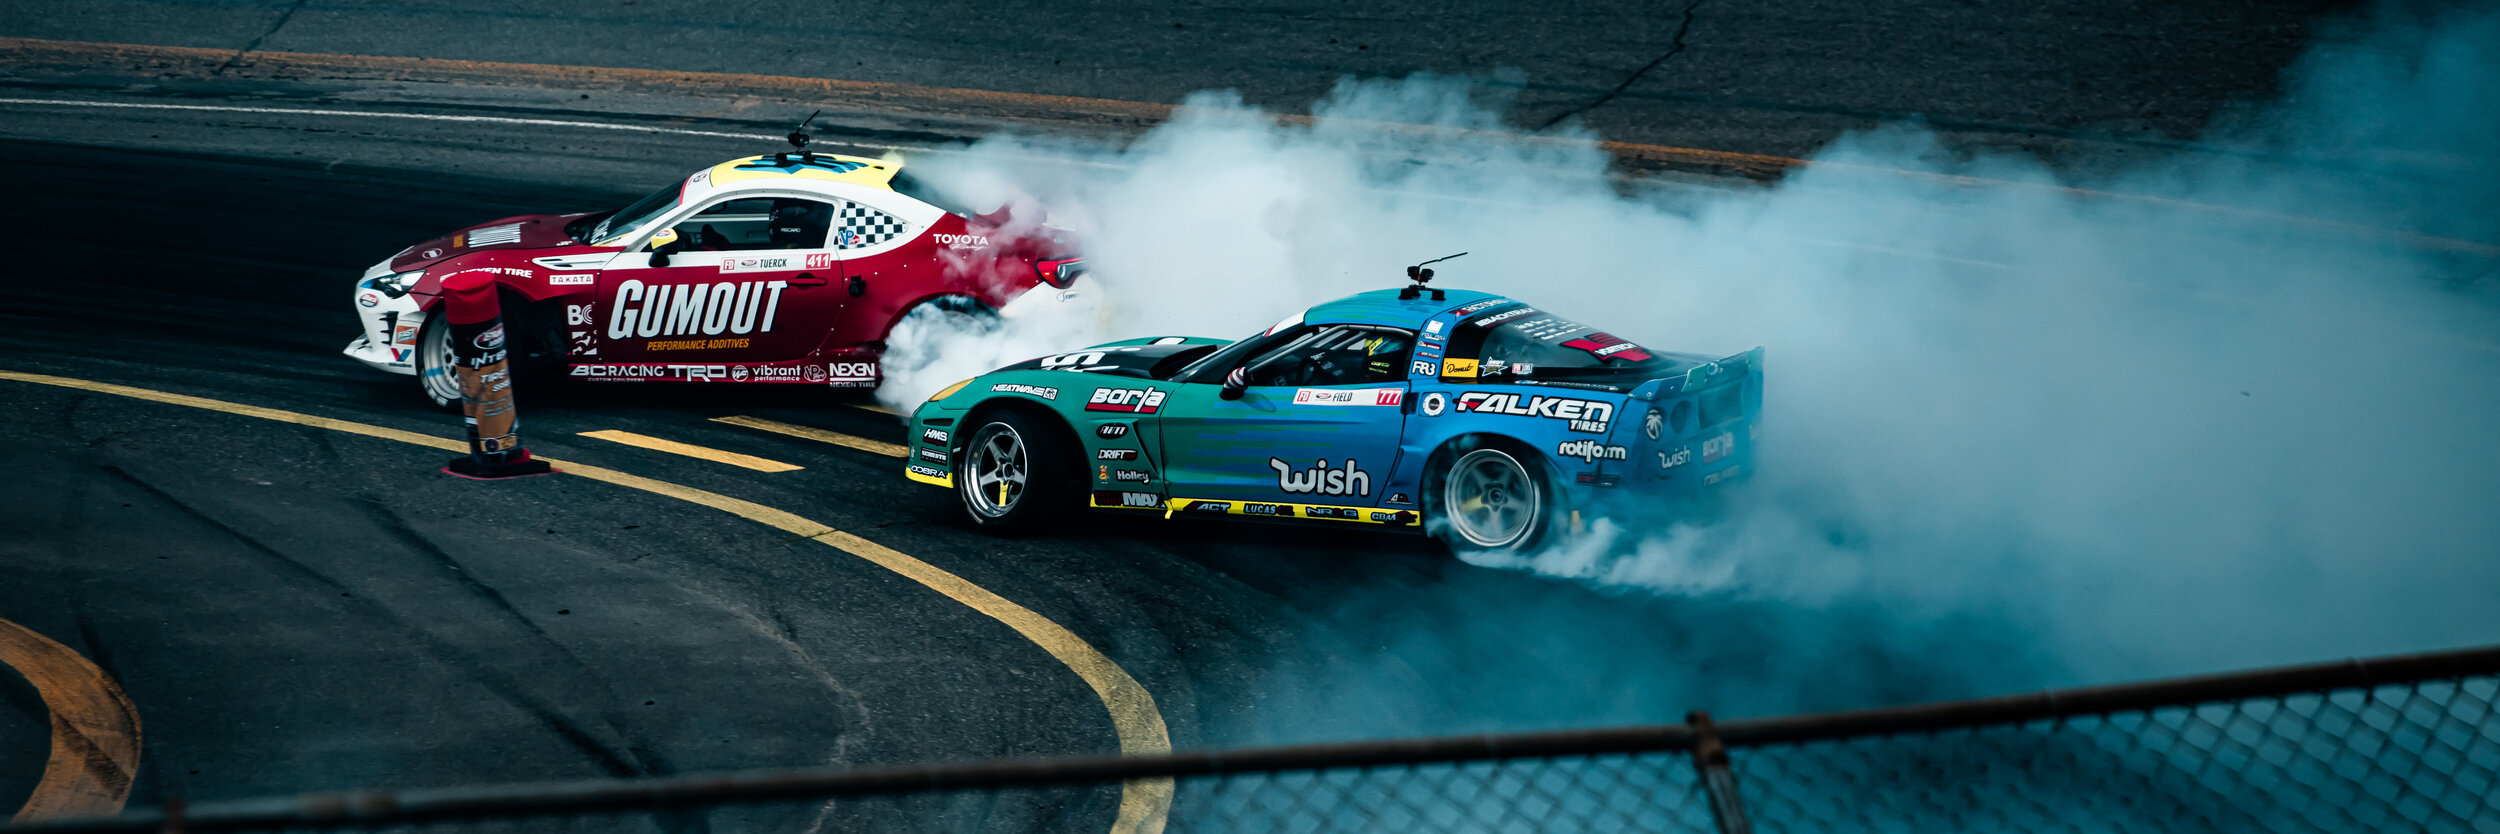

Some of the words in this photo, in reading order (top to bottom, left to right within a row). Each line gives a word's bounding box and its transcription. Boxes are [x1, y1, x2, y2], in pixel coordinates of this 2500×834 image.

[933, 233, 989, 245] TOYOTA
[760, 258, 788, 268] TUERCK
[806, 255, 830, 268] 411
[504, 267, 533, 279] TIRE
[552, 275, 592, 284] TAKATA
[607, 279, 789, 340] GUMOUT
[647, 339, 706, 352] PERFORMANCE
[707, 338, 750, 350] ADDITIVES
[753, 364, 801, 376] vibrant
[829, 363, 876, 377] NEXEN
[991, 384, 1045, 396] HEATWAVE
[1333, 392, 1353, 402] FIELD
[1379, 390, 1401, 405] 777
[1455, 392, 1614, 422] FALKEN
[1570, 420, 1606, 432] TIRES
[924, 428, 948, 442] HMS
[1098, 449, 1133, 459] DRIFT
[1559, 441, 1626, 463] rotiform
[911, 465, 946, 478] COBRA
[1117, 470, 1150, 483] Holley
[1245, 503, 1276, 514] LUCAS
